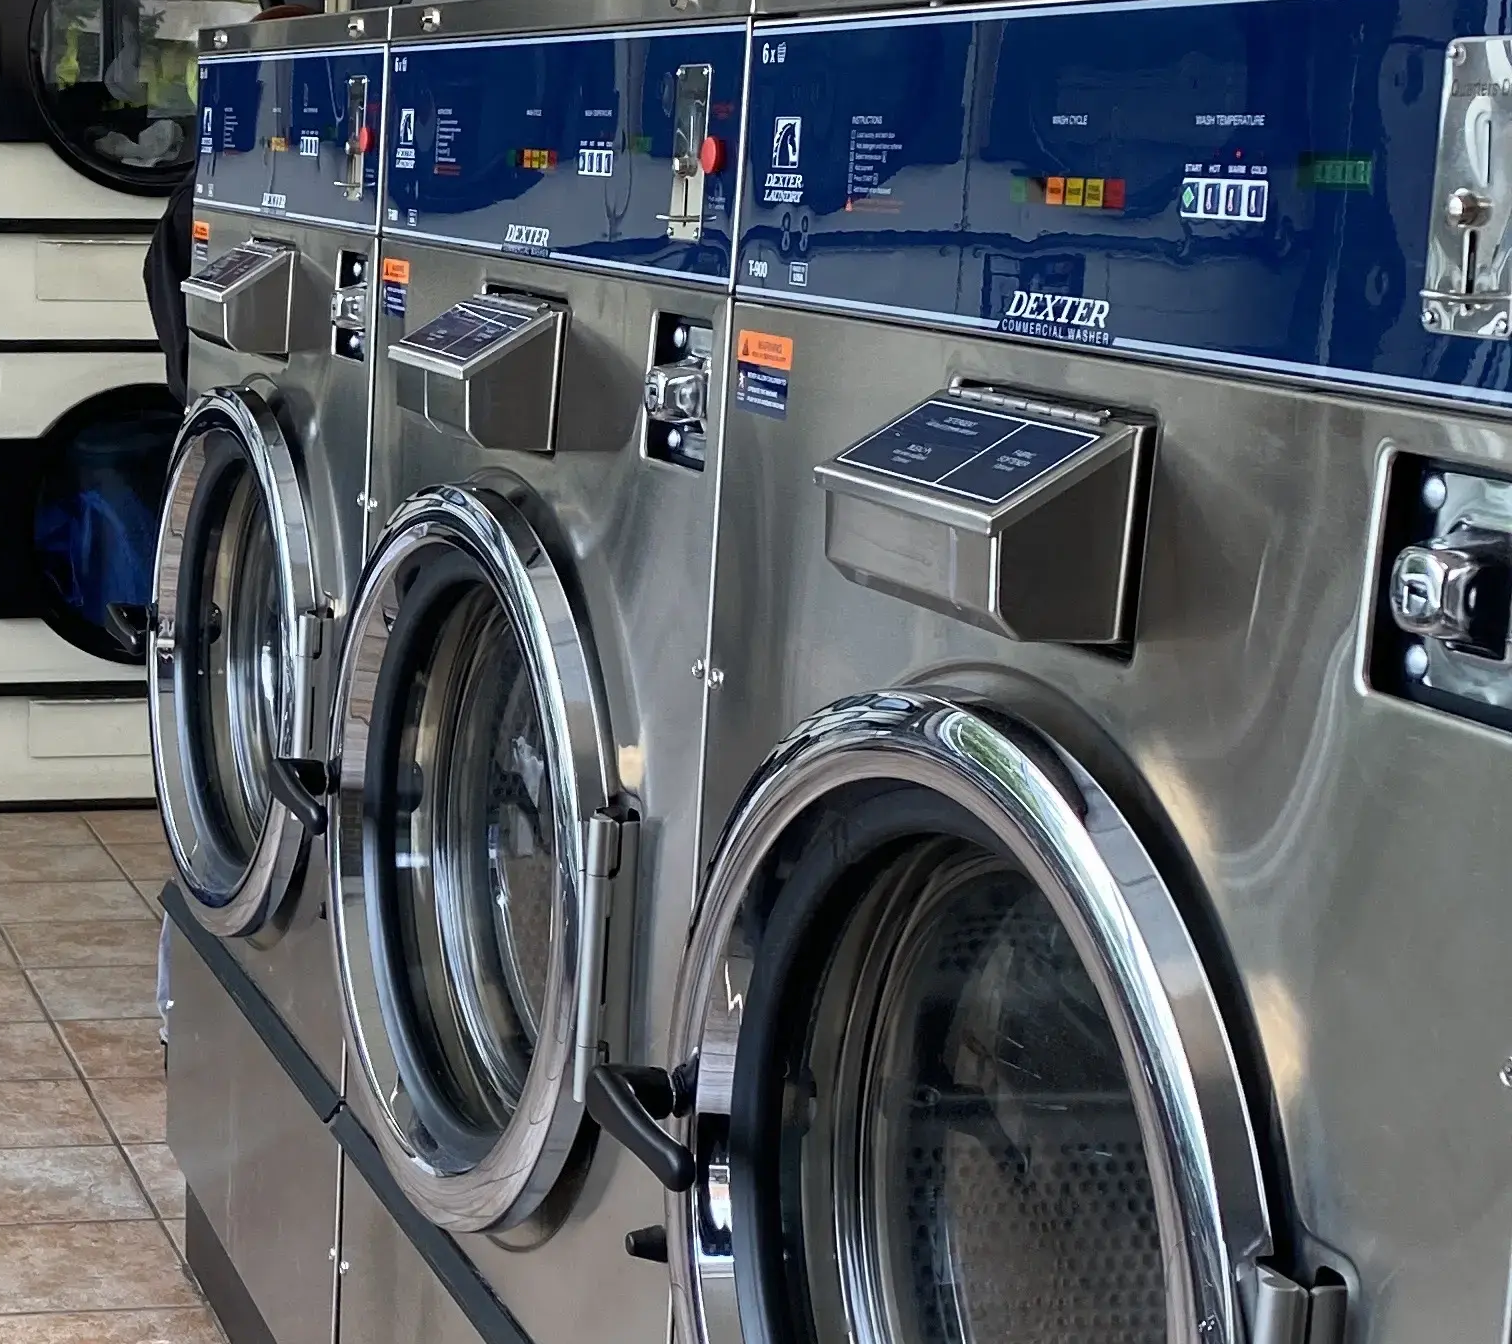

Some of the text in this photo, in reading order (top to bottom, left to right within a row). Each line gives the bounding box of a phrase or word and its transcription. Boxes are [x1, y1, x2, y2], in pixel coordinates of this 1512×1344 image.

[1069, 115, 1088, 125] CYCLE
[1195, 115, 1265, 126] WASH TEMPERATURE
[1185, 164, 1202, 172] START
[1209, 164, 1221, 173] HOT
[1251, 166, 1267, 174] COLD
[764, 174, 804, 188] DEXTER
[763, 190, 804, 203] LAUNDRY
[505, 224, 550, 247] DEXTER
[748, 260, 768, 278] T-900
[1005, 290, 1110, 329] DEXTER
[1001, 319, 1109, 345] COMMERCIAL WASHER
